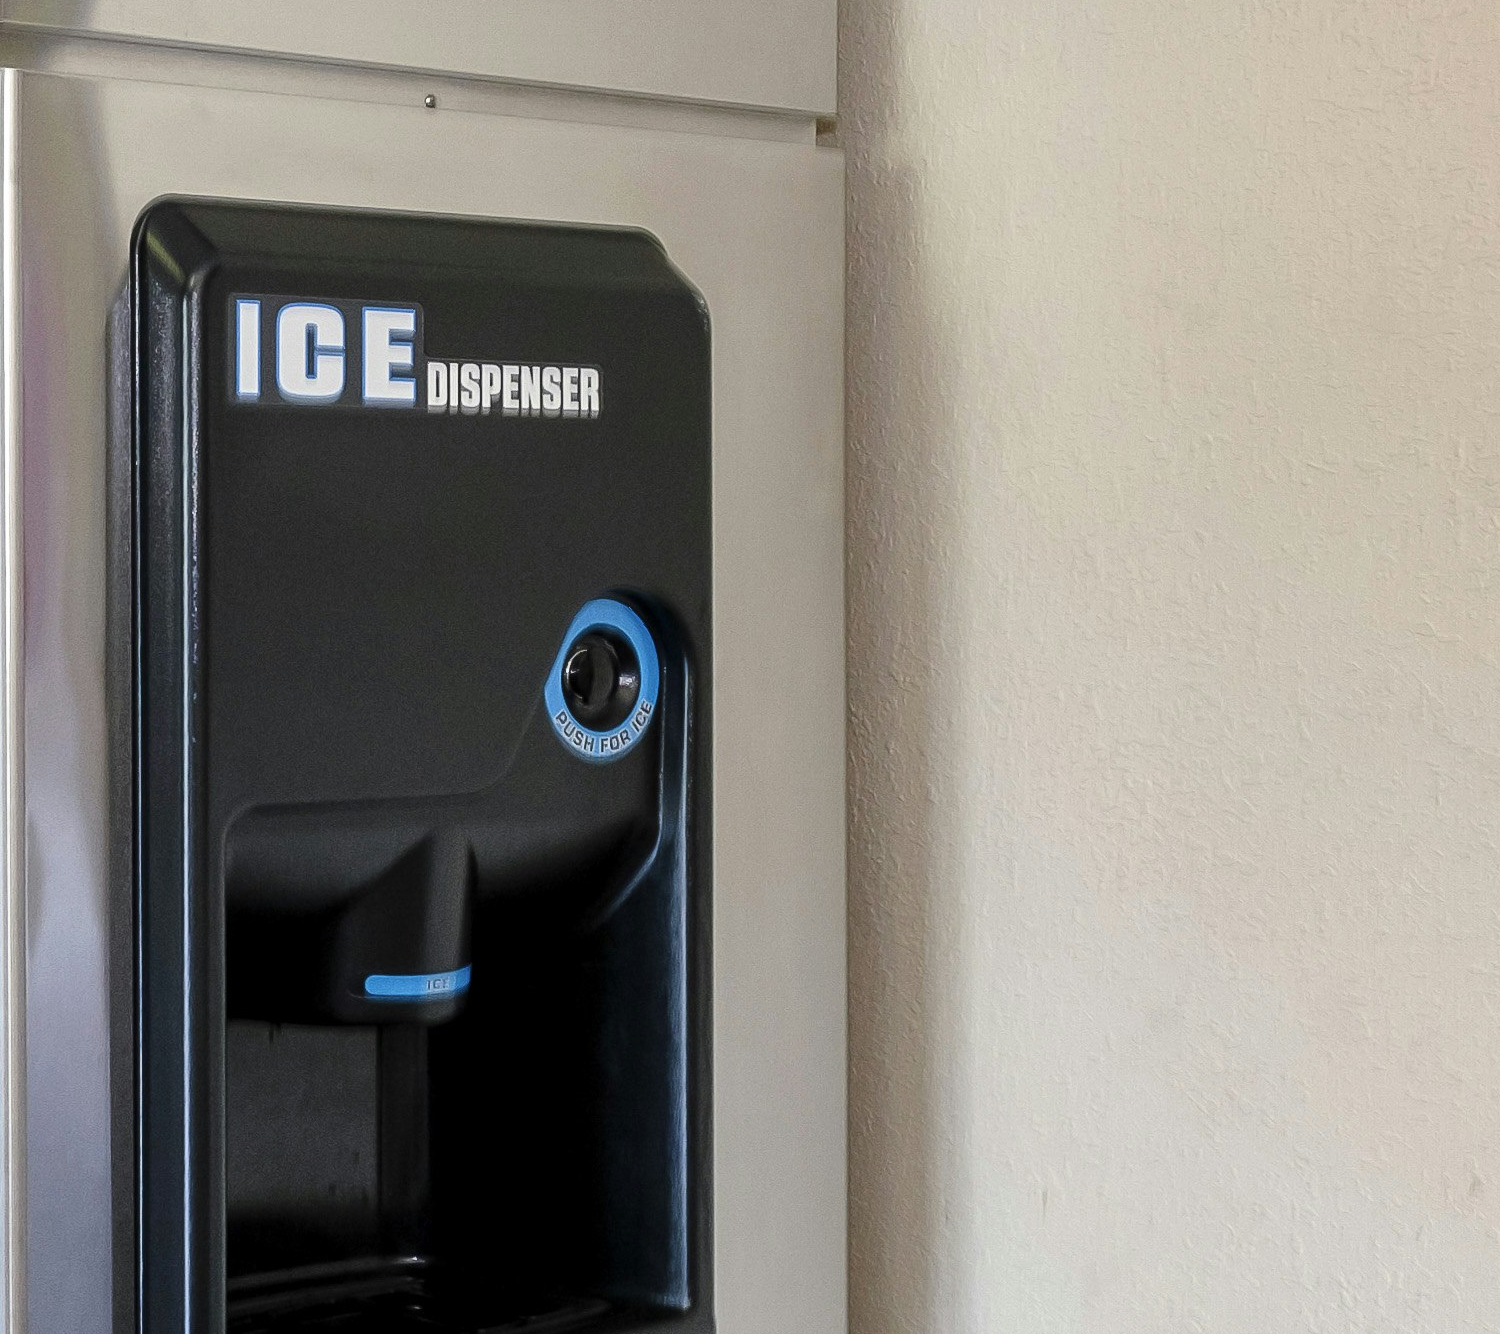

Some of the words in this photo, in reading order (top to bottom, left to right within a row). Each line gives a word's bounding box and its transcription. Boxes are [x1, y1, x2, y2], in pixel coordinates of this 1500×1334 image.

[236, 299, 417, 407] ICE
[427, 361, 600, 419] DISPENSER
[555, 711, 594, 752] PUSH
[600, 729, 632, 753] FOR
[632, 701, 652, 732] ICE
